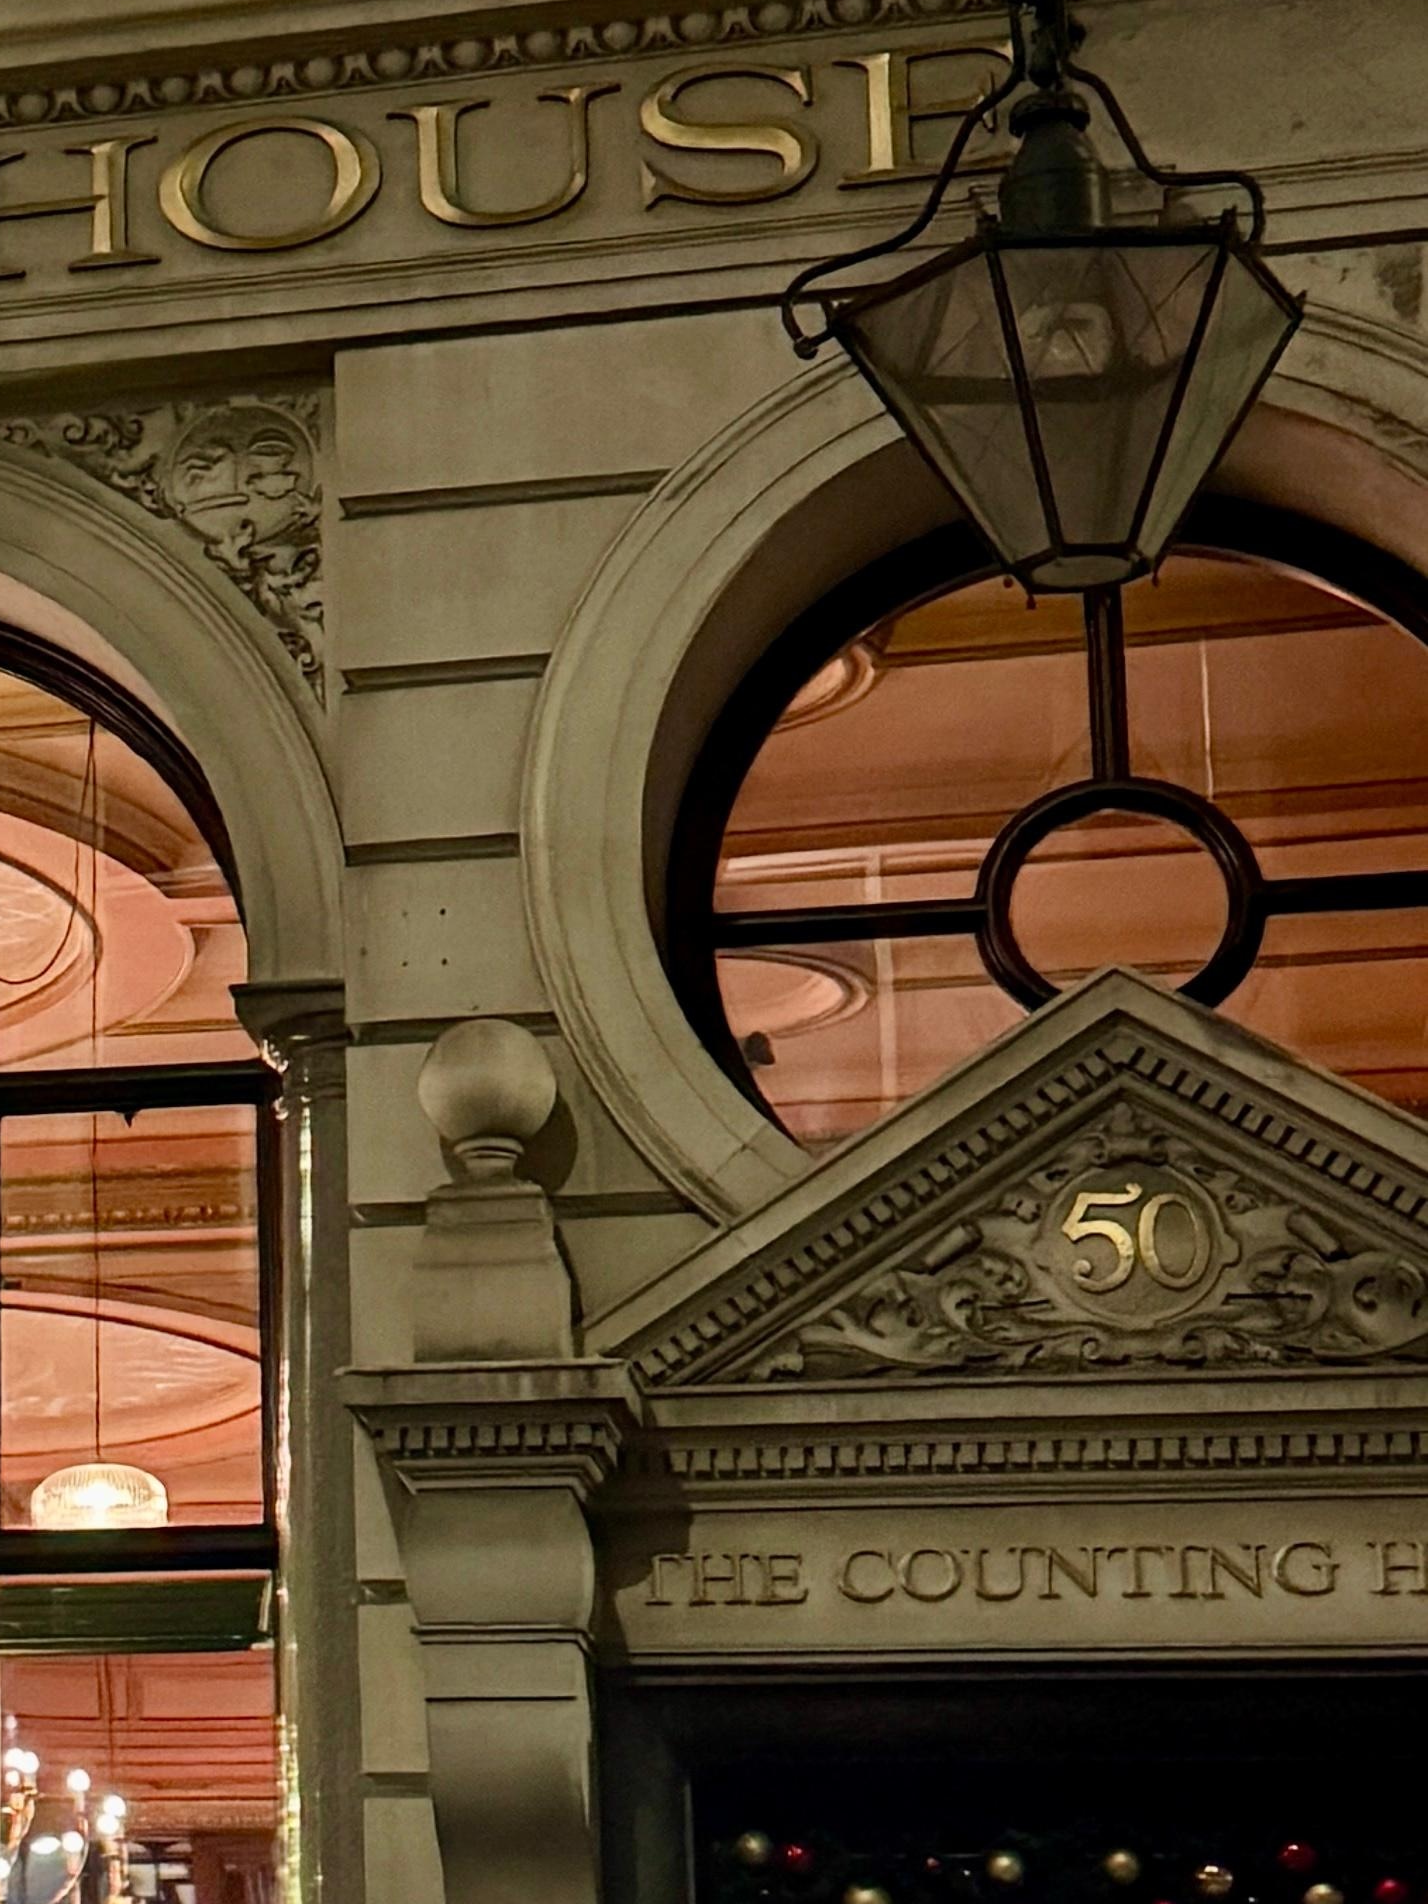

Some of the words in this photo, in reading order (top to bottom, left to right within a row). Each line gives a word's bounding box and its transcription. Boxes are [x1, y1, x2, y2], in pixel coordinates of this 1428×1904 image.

[1060, 1181, 1211, 1293] 50
[643, 1551, 810, 1608] THE
[836, 1541, 1342, 1605] COUNTING
